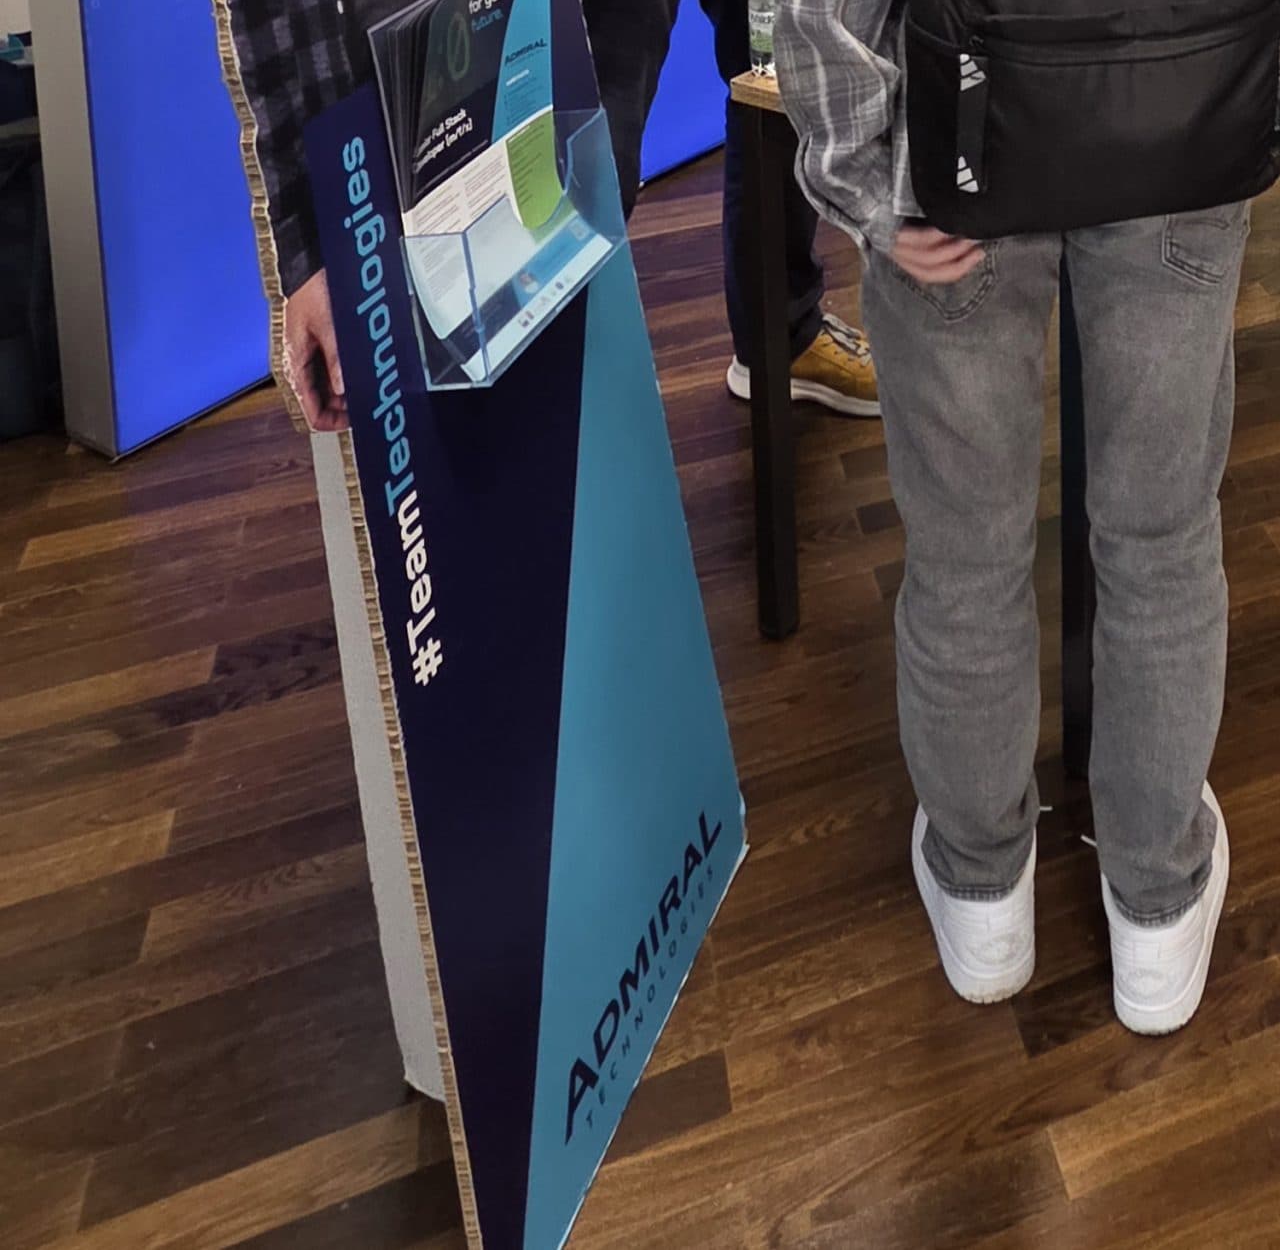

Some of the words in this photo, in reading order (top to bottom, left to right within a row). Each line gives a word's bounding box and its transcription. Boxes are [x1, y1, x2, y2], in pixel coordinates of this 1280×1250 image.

[343, 136, 443, 686] #TeamTechnologies
[565, 810, 722, 1144] ADMIRAL
[585, 867, 714, 1129] TECHNOLOGIES
